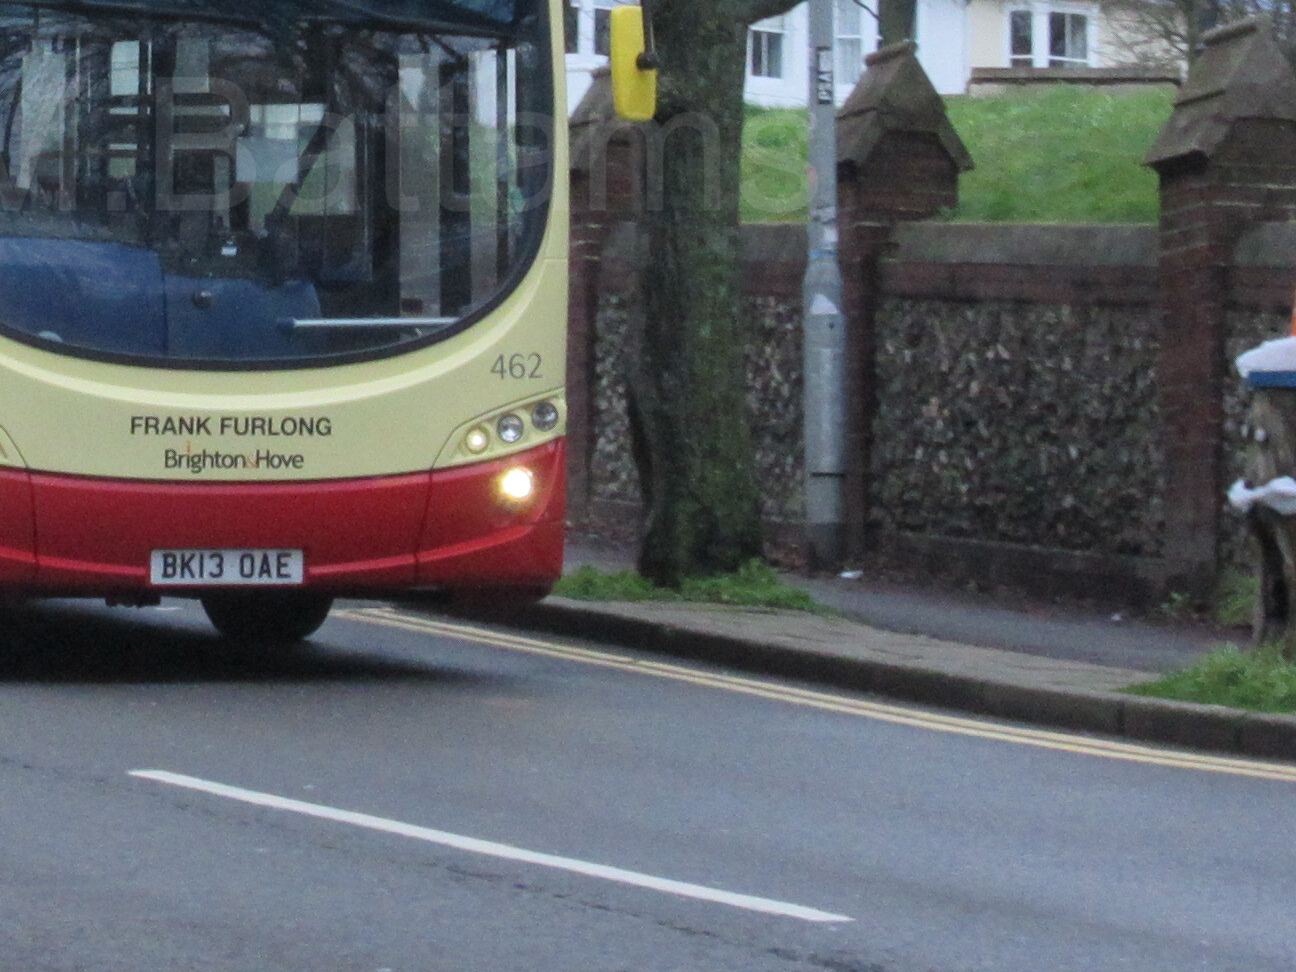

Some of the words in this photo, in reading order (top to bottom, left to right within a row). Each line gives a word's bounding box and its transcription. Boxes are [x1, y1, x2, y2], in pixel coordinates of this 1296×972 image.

[490, 352, 543, 380] 462
[130, 416, 212, 436] FRANK
[220, 416, 333, 438] FURLONG
[161, 552, 224, 579] BK13
